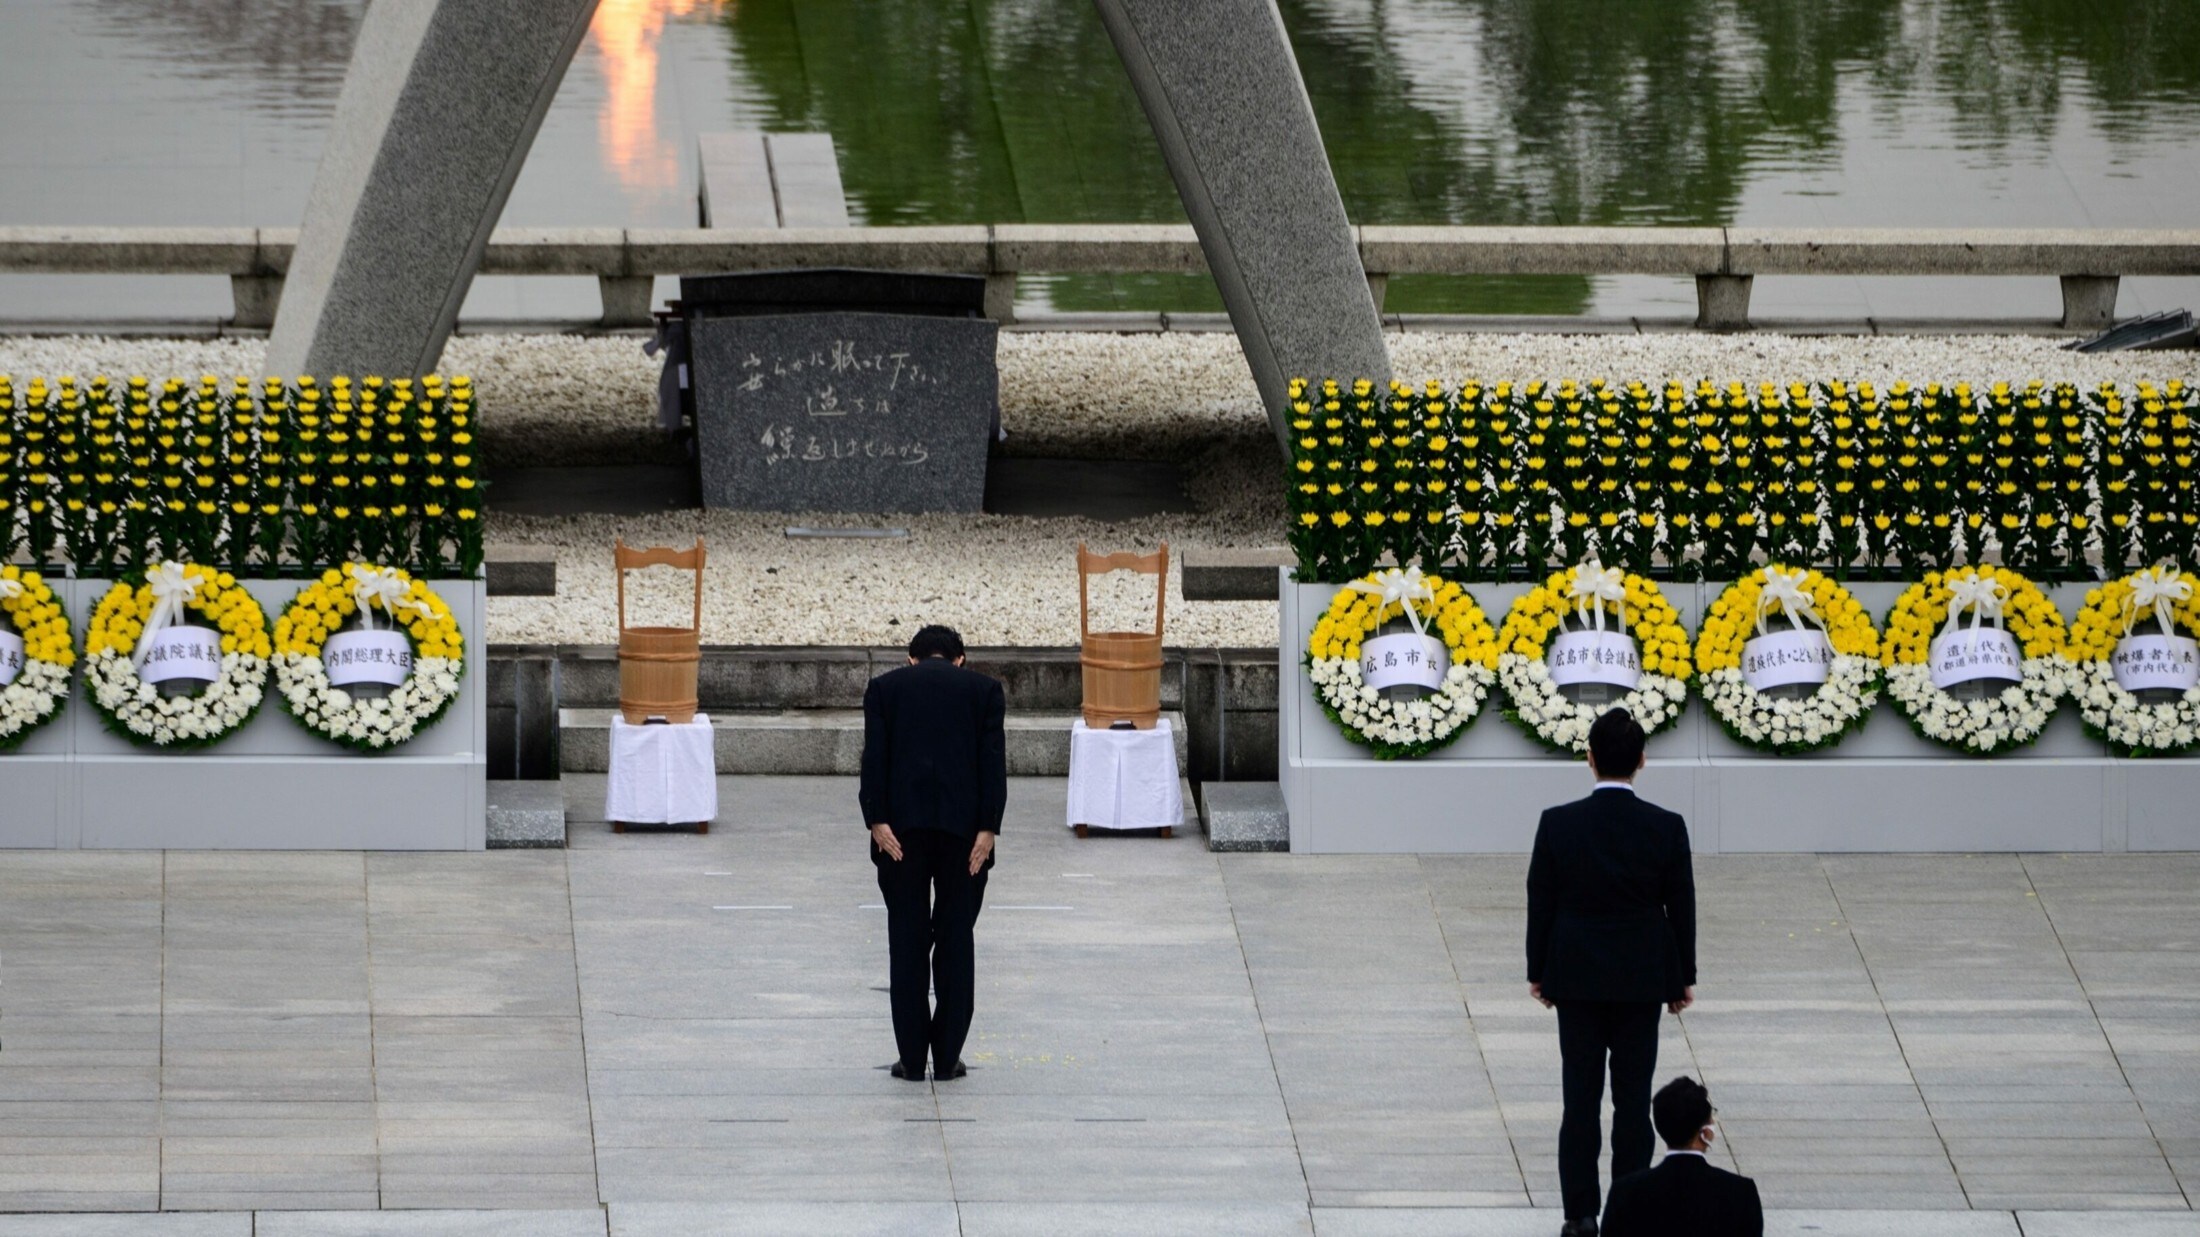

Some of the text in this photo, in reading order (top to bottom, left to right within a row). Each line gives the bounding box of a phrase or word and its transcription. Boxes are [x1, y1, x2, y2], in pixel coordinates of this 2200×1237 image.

[807, 384, 891, 417] 過ちは
[328, 647, 409, 668] 内閣総理大臣
[1366, 648, 1438, 674] 広島市長
[1555, 646, 1636, 671] 広島市議会議長
[1747, 647, 1828, 673] 遺族代表・こども表
[1947, 640, 2009, 658] 遺代表
[2125, 662, 2186, 676] (市内代表)
